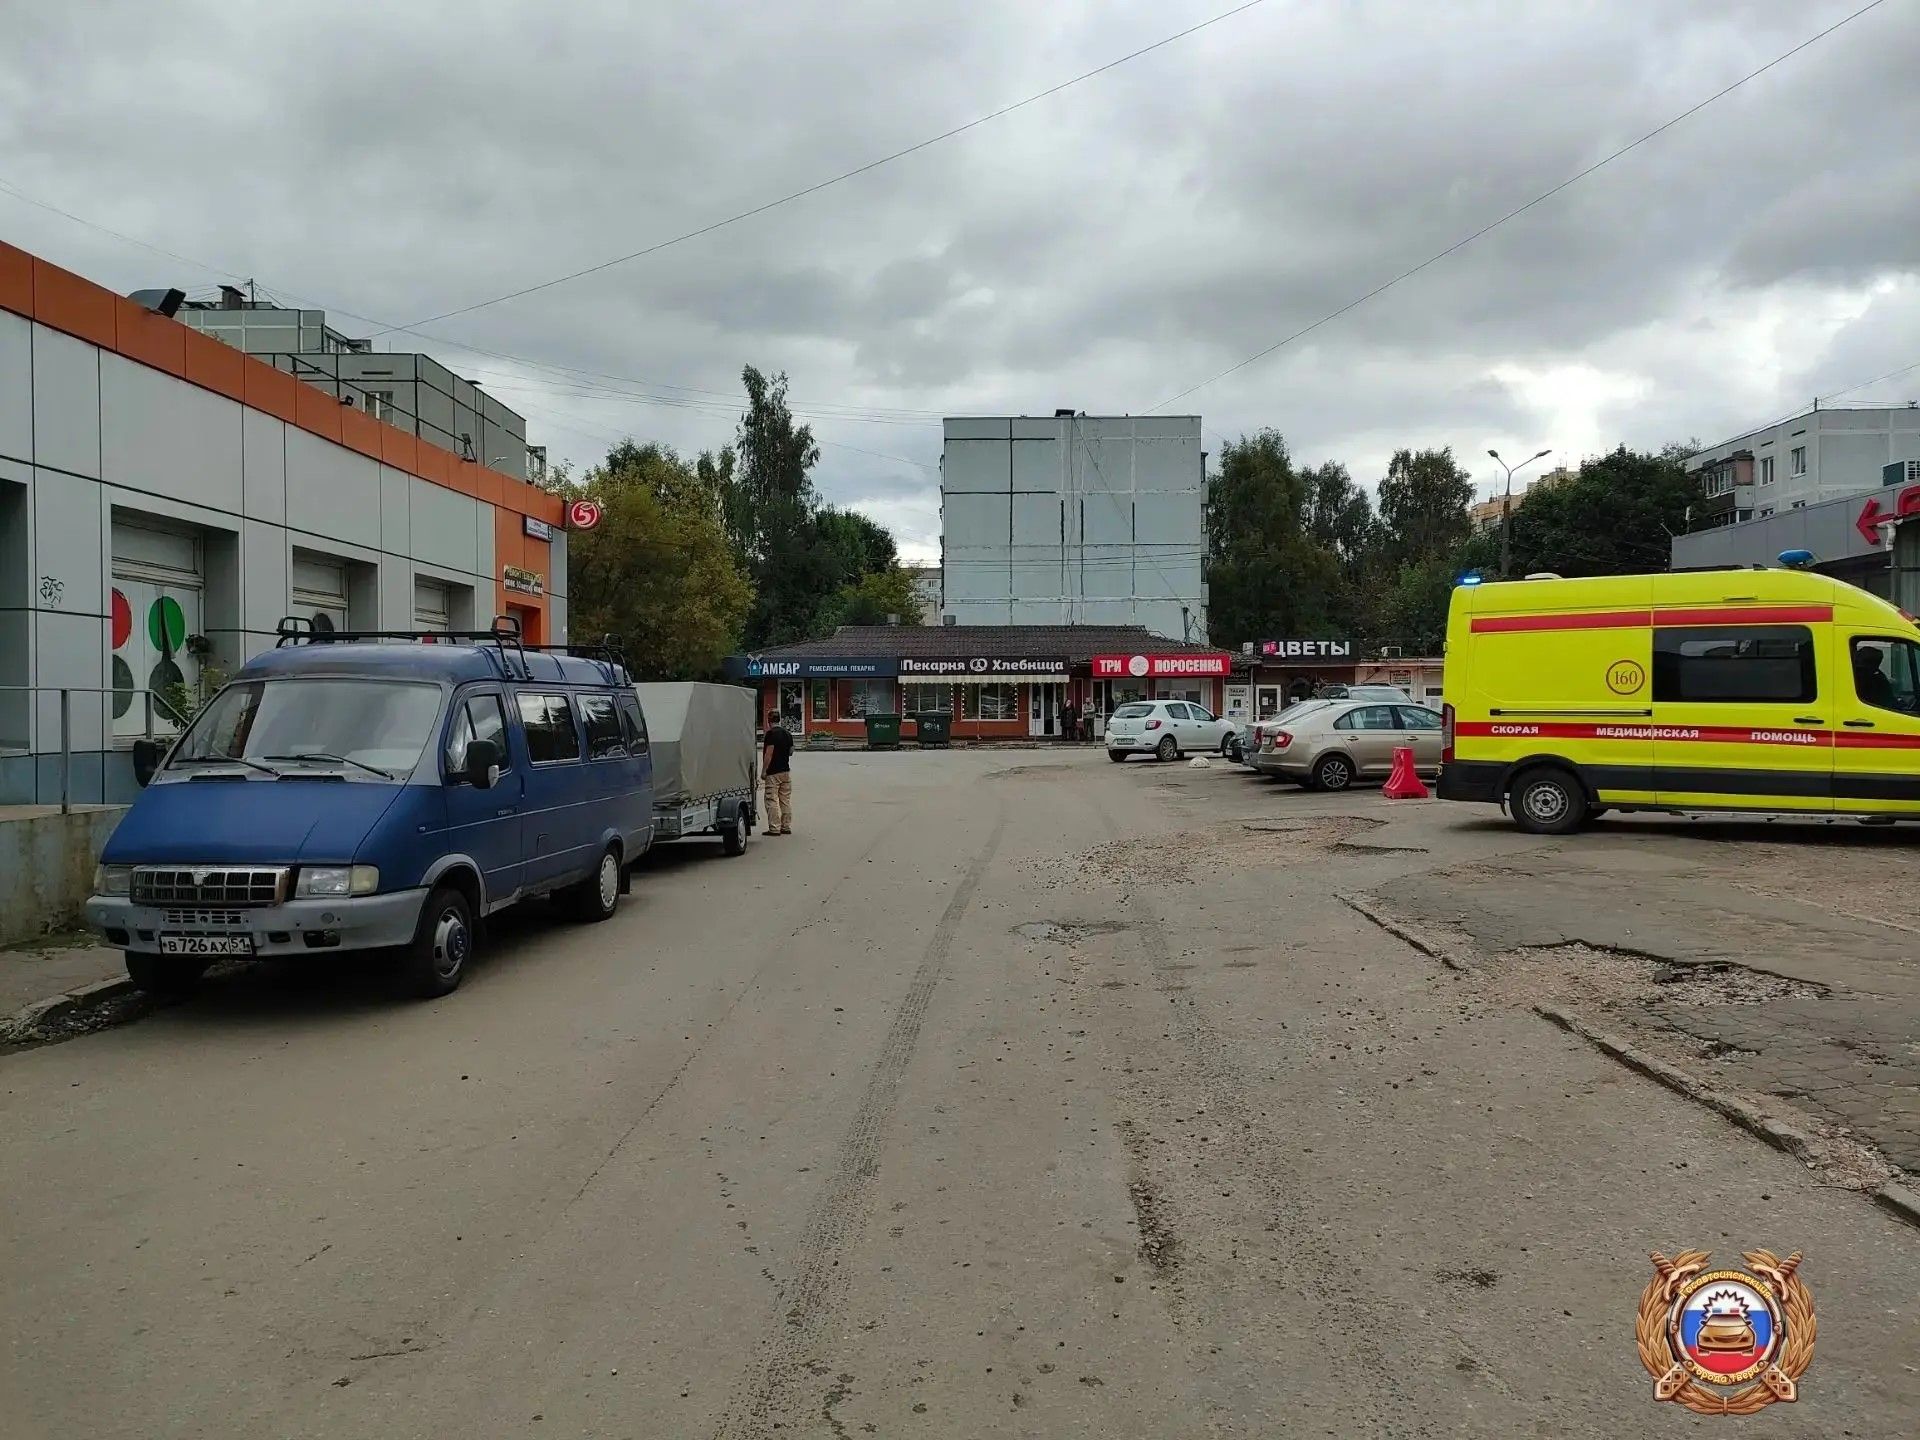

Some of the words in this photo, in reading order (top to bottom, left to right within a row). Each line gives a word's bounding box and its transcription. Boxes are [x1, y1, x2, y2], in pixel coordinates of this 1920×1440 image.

[1270, 641, 1350, 657] ЦВЕТЫ
[762, 662, 800, 675] АМБАР
[903, 659, 966, 673] Пекарня
[992, 659, 1064, 673] Хлебница
[1100, 660, 1122, 673] ТРИ
[1154, 659, 1223, 673] ПОРОСЕНКА
[1614, 670, 1638, 685] 160
[1491, 725, 1539, 734] СКОРАЯ
[1596, 727, 1699, 738] МЕДИЦИНСКАЯ
[1751, 731, 1817, 743] ПОМОЩЬ
